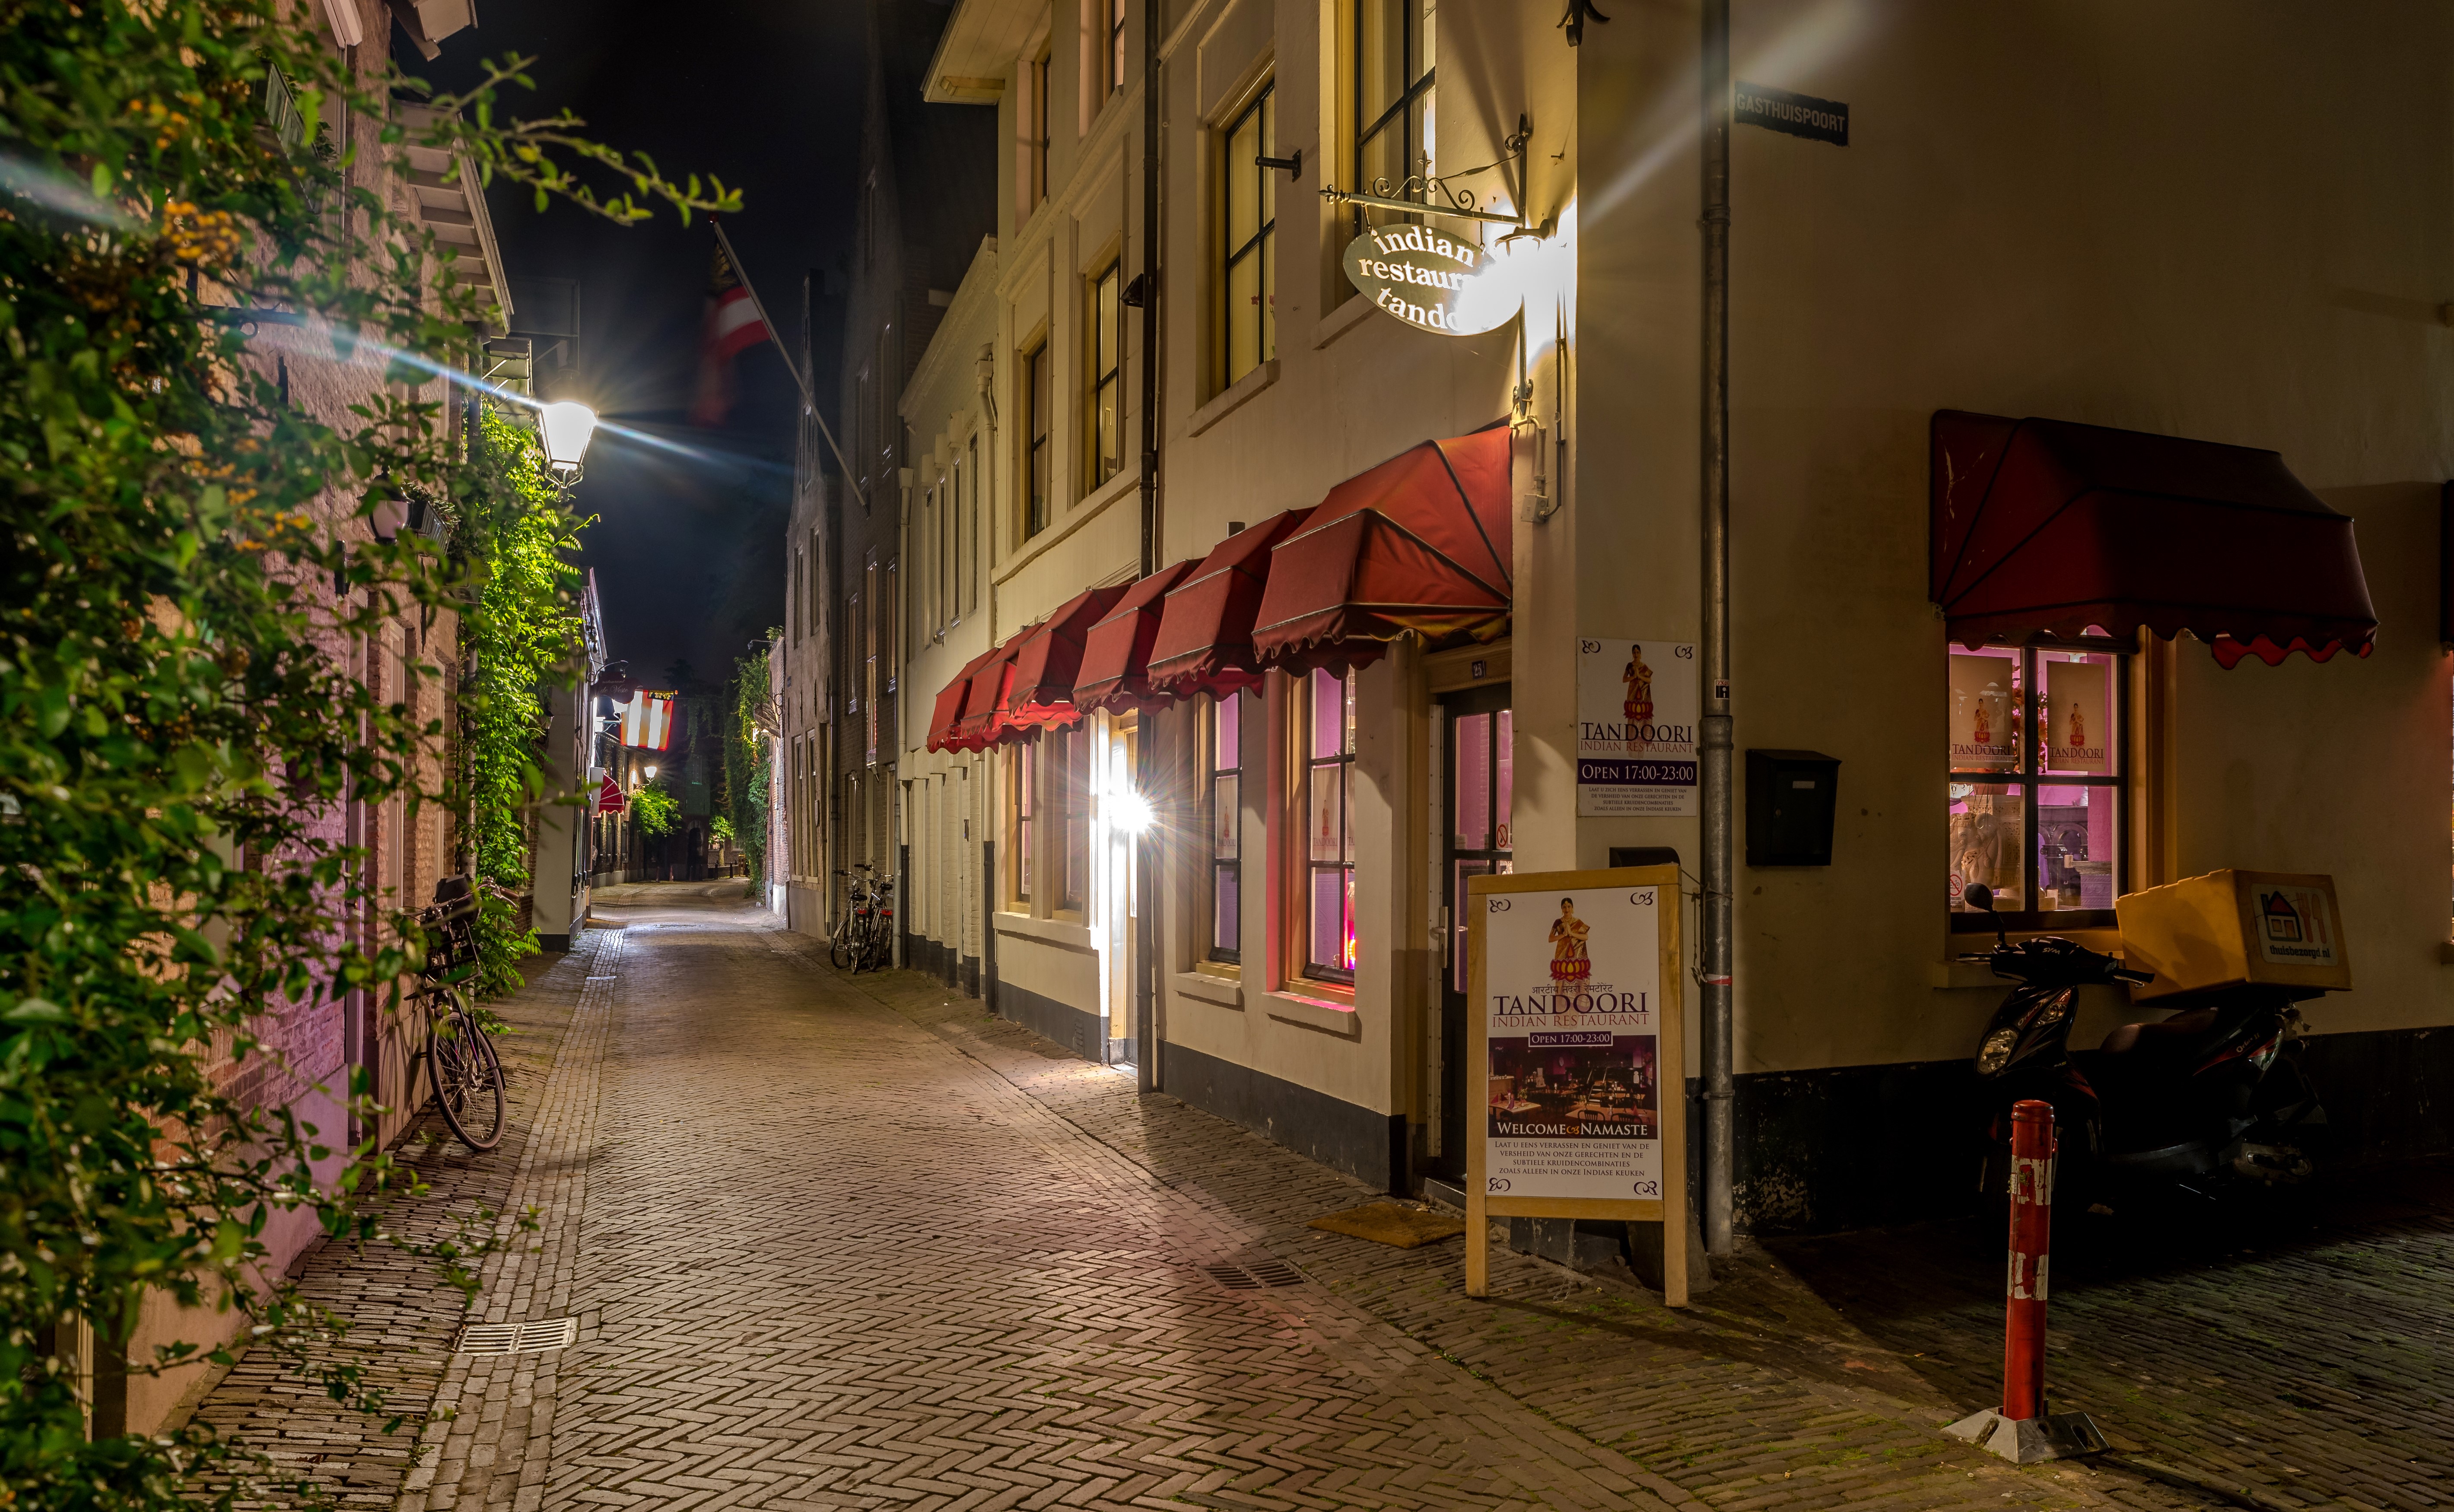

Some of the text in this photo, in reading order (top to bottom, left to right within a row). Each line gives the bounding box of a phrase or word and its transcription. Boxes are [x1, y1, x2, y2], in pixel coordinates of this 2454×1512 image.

[1736, 93, 1845, 132] GASTHUISPOORT
[1370, 225, 1475, 268] indian
[1473, 663, 1482, 677] 23
[1581, 722, 1693, 743] TANDOORI
[1580, 741, 1693, 753] INDIAN RESTAURANT
[1952, 744, 2011, 756] TANDOORI
[2050, 747, 2104, 759] TANDOORI
[1625, 766, 1693, 780] 17:00-23:00
[1313, 838, 1338, 846] TANDOORI
[1493, 992, 1650, 1015] TANDOORI
[1493, 1013, 1650, 1027] INDIAN RESTAURANT
[1561, 1034, 1610, 1043] 17:00-23:00
